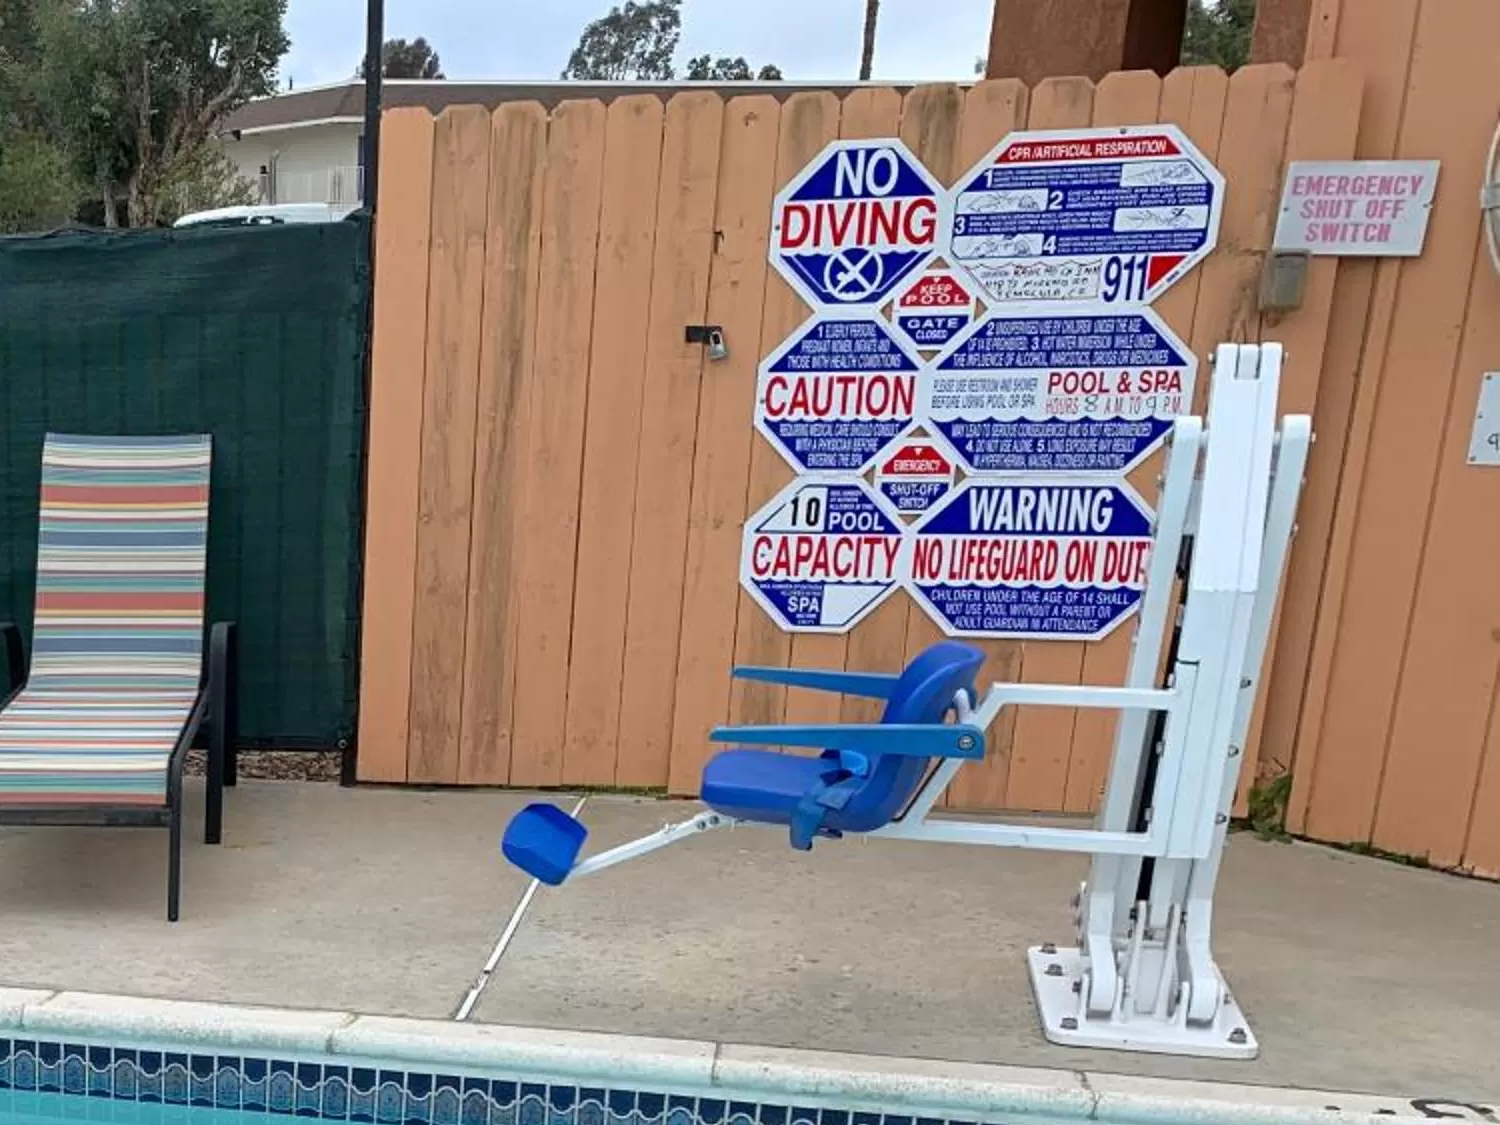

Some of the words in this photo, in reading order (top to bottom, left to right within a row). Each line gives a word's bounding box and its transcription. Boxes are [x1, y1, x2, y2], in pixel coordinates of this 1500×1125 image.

[1095, 139, 1167, 157] RESPIRATION
[834, 149, 899, 197] NO
[984, 171, 993, 188] 1
[1291, 175, 1424, 197] EMERGENCY
[1050, 191, 1064, 209] 2
[1300, 199, 1358, 219] SHUT
[1365, 199, 1406, 219] OFF
[780, 198, 937, 248] DIVING
[955, 215, 965, 234] 3
[1305, 223, 1392, 243] SWITCH
[1043, 236, 1057, 254] 4
[1103, 255, 1149, 302] 911
[906, 293, 964, 304] POOL
[920, 284, 953, 295] KEEP
[907, 318, 959, 328] GATE
[986, 321, 995, 336] 2
[915, 329, 948, 339] CLOSED
[1030, 336, 1039, 350] 3
[1047, 371, 1110, 395] POOL
[1117, 370, 1132, 394] &
[1138, 370, 1182, 393] SPA
[765, 375, 915, 417] CAUTION
[1045, 396, 1079, 415] HOURS
[1084, 394, 1099, 413] 8
[1129, 396, 1141, 414] TO
[1145, 395, 1157, 415] 9
[894, 460, 941, 472] EMERGENCY
[889, 484, 940, 497] SHUT-OFF
[791, 496, 821, 527] 10
[898, 497, 929, 509] SWITCH
[969, 487, 1114, 532] WARNING
[828, 511, 884, 531] POOL
[753, 536, 902, 579] CAPACITY
[911, 537, 943, 580] NO
[948, 538, 1059, 581] LIFEGUARD
[1065, 539, 1098, 582] ON
[1102, 540, 1151, 583] DUT
[787, 598, 820, 613] SPA
[931, 588, 981, 601] CHILDREN
[984, 589, 1018, 602] UNDER
[1021, 590, 1039, 602] THE
[1042, 591, 1063, 604] AGE
[1065, 591, 1078, 604] OF
[1082, 592, 1093, 604] 14
[1097, 592, 1129, 605] SHALL
[945, 602, 962, 615] NOT
[965, 603, 983, 615] USE
[984, 603, 1007, 616] POOL
[1009, 604, 1050, 617] WITHOUT
[1051, 604, 1059, 616] A
[1060, 606, 1095, 618] PARENT
[1098, 606, 1112, 618] OR
[954, 616, 981, 629] ADULT
[983, 617, 1028, 630] GUARDIAN
[1041, 618, 1099, 631] ATTENDANCE
